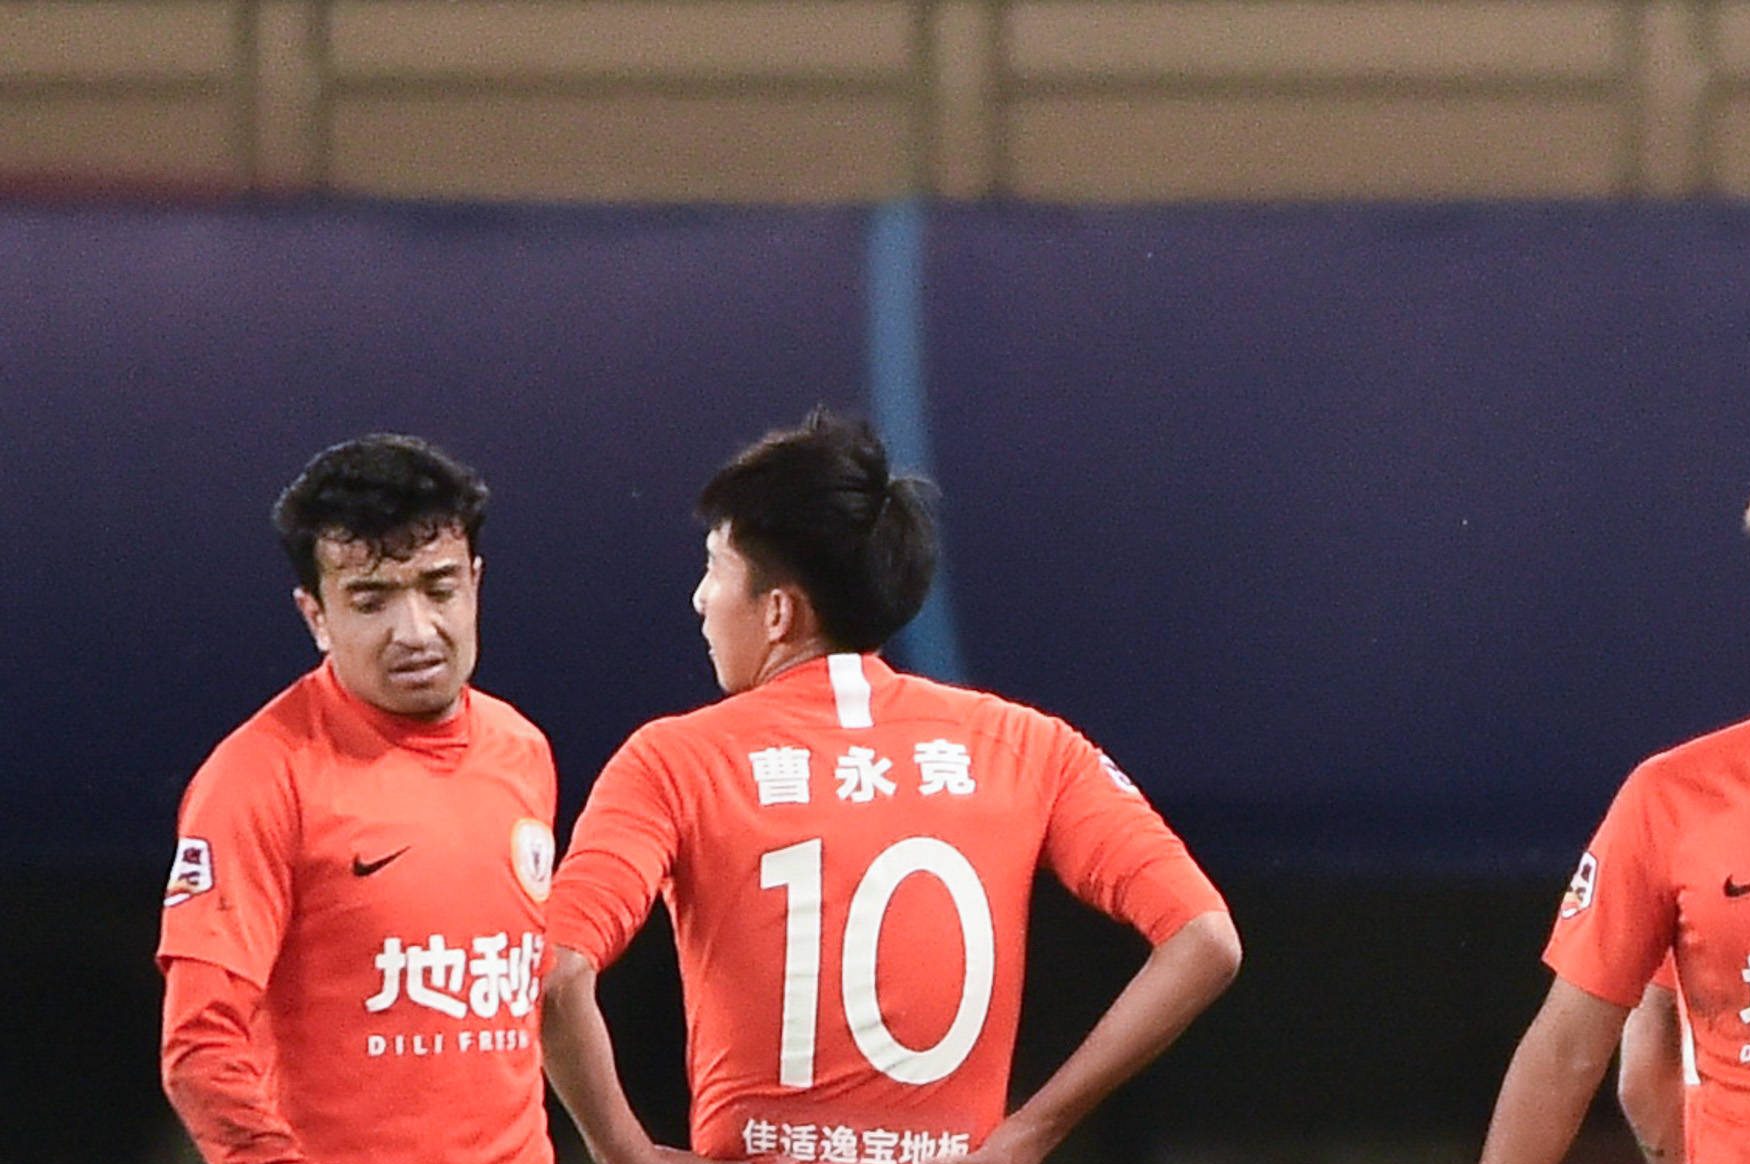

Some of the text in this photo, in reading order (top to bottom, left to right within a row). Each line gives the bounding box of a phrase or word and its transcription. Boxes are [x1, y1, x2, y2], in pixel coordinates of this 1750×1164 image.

[748, 738, 977, 806] 曹永竞
[760, 836, 995, 1088] 10
[367, 1034, 444, 1057] DILI
